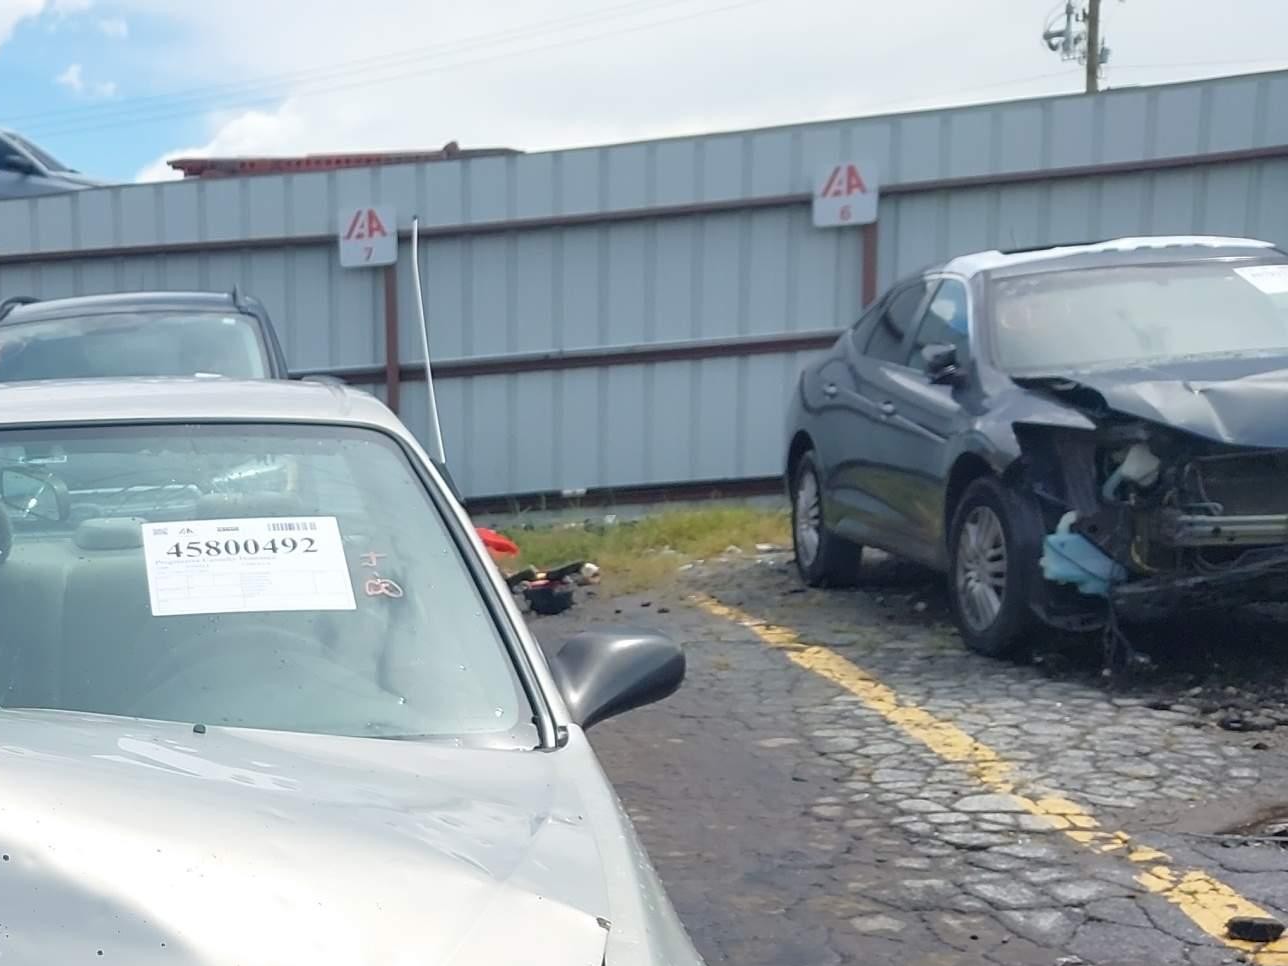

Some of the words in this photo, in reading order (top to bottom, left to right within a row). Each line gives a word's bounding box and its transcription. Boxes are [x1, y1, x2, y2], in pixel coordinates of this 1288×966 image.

[840, 204, 851, 221] 6
[364, 247, 373, 261] 7
[166, 537, 319, 558] 45800492
